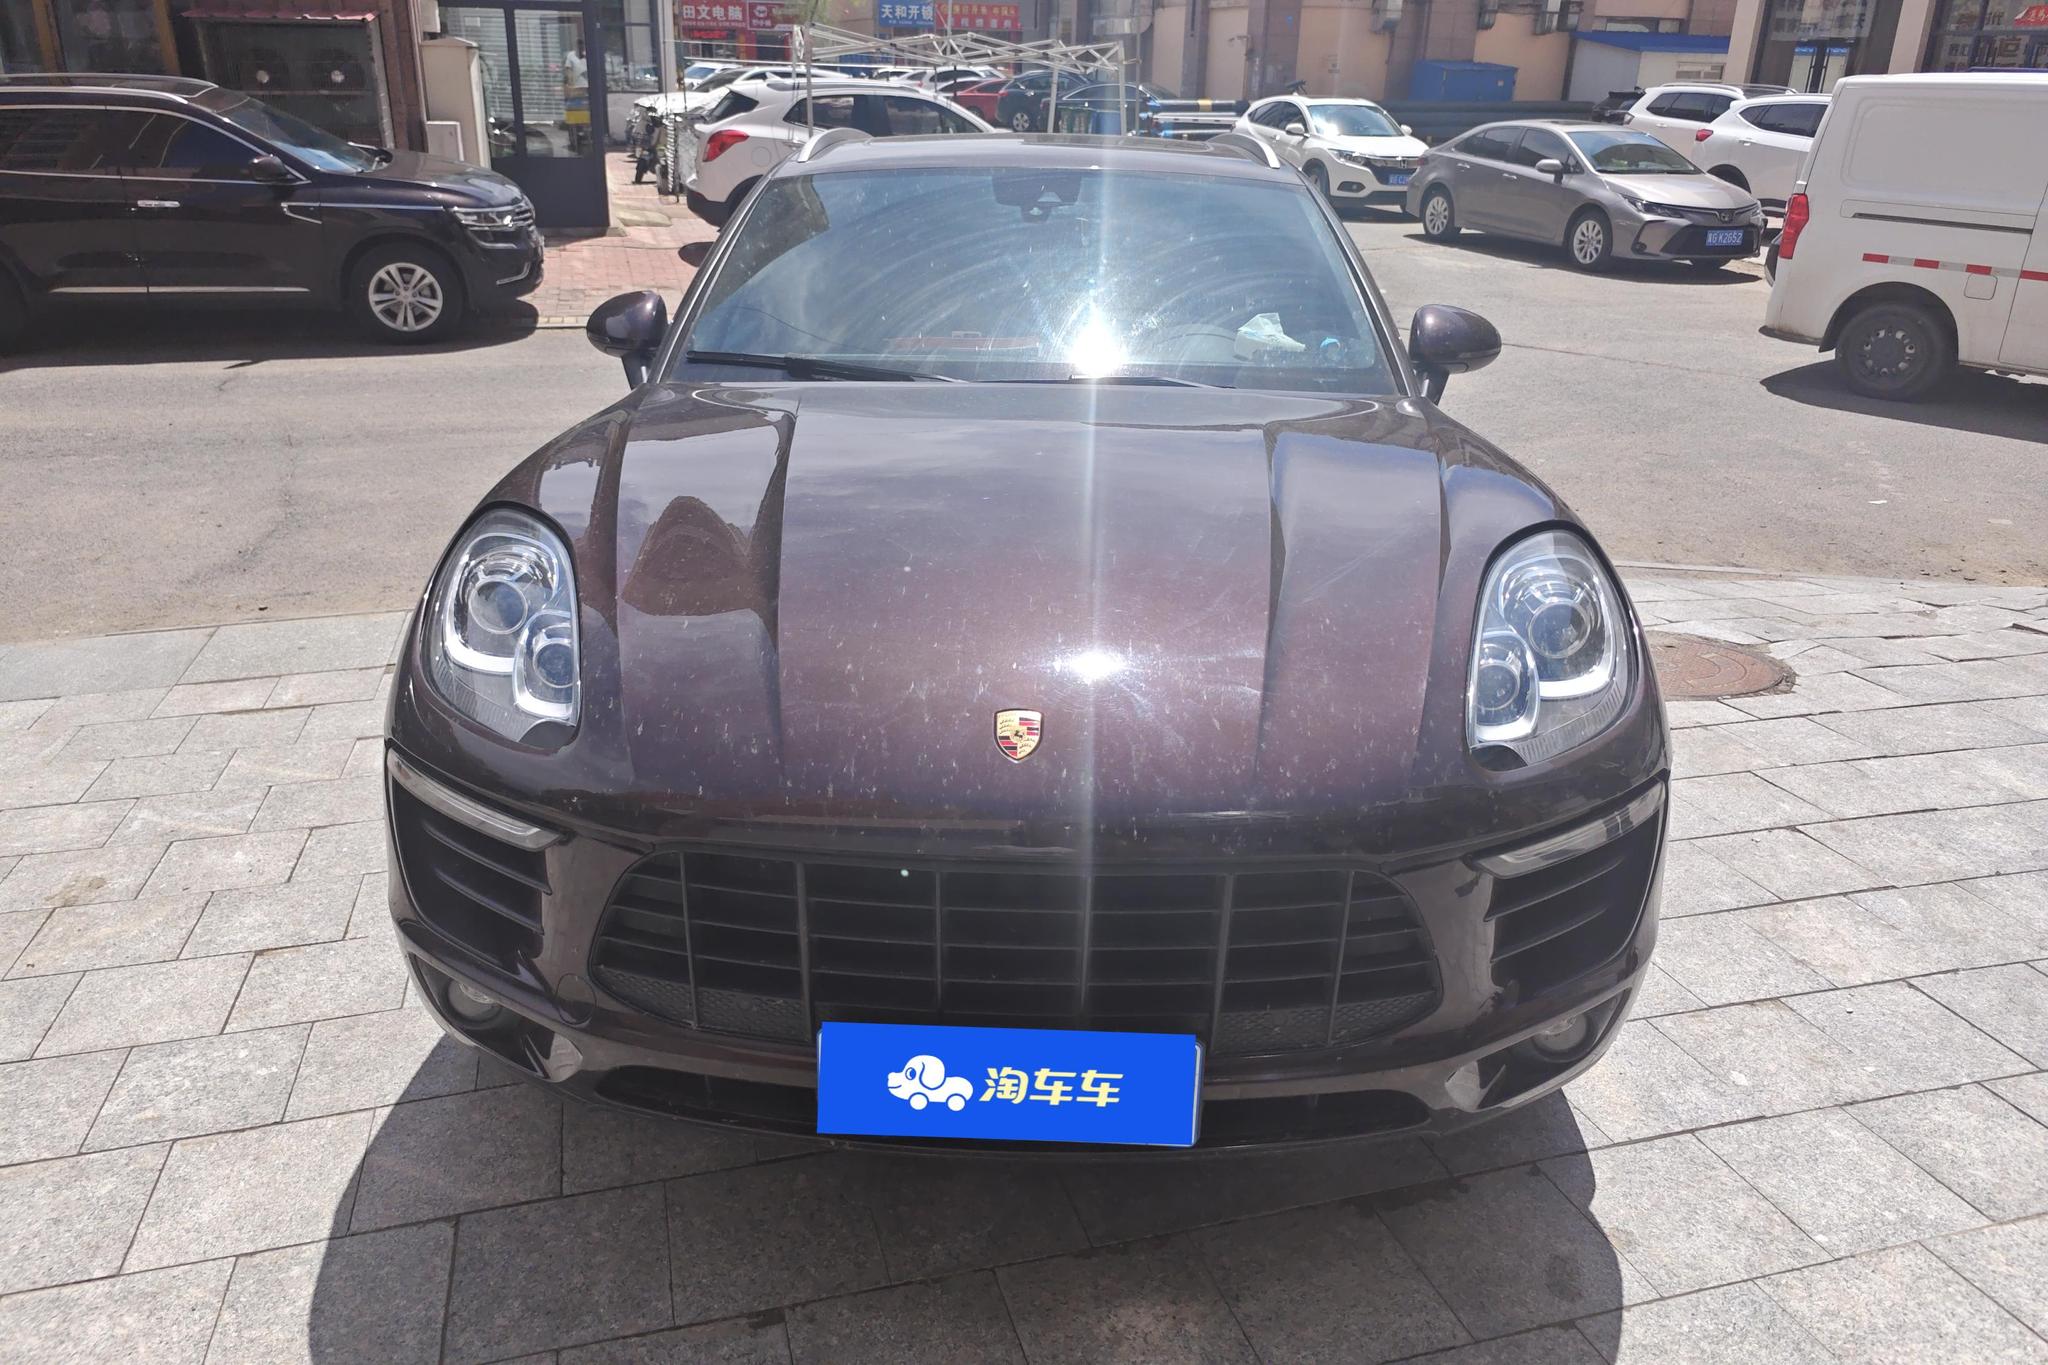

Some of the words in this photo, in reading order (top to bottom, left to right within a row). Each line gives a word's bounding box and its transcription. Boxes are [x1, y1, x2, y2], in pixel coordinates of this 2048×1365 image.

[683, 4, 743, 20] 田文电脑
[881, 4, 934, 21] 天和开锁
